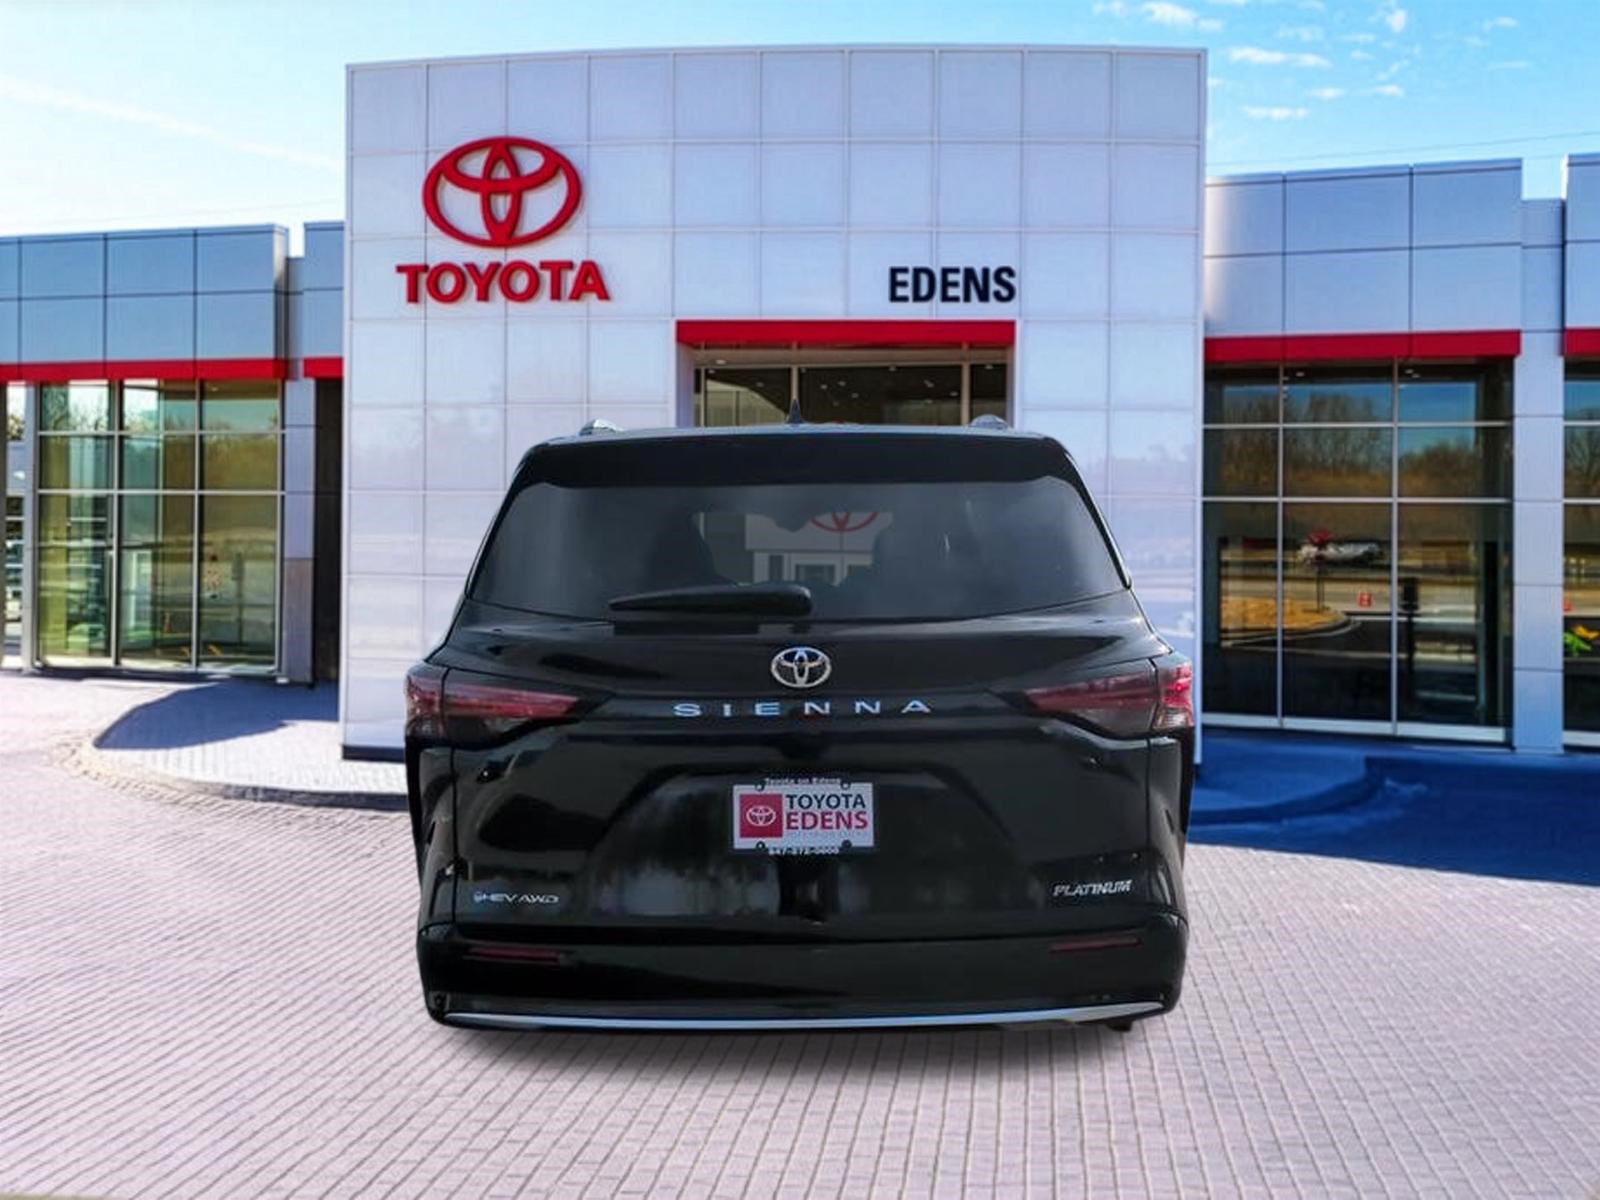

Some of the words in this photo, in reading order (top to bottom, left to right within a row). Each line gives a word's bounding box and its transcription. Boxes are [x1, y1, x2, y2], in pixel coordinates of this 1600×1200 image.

[395, 260, 611, 304] TOYOTA
[889, 266, 1017, 303] EDENS
[673, 700, 932, 718] SIENNA
[785, 793, 866, 809] TOYOTA
[785, 811, 868, 830] EDENS
[1053, 880, 1133, 896] PLATINUM
